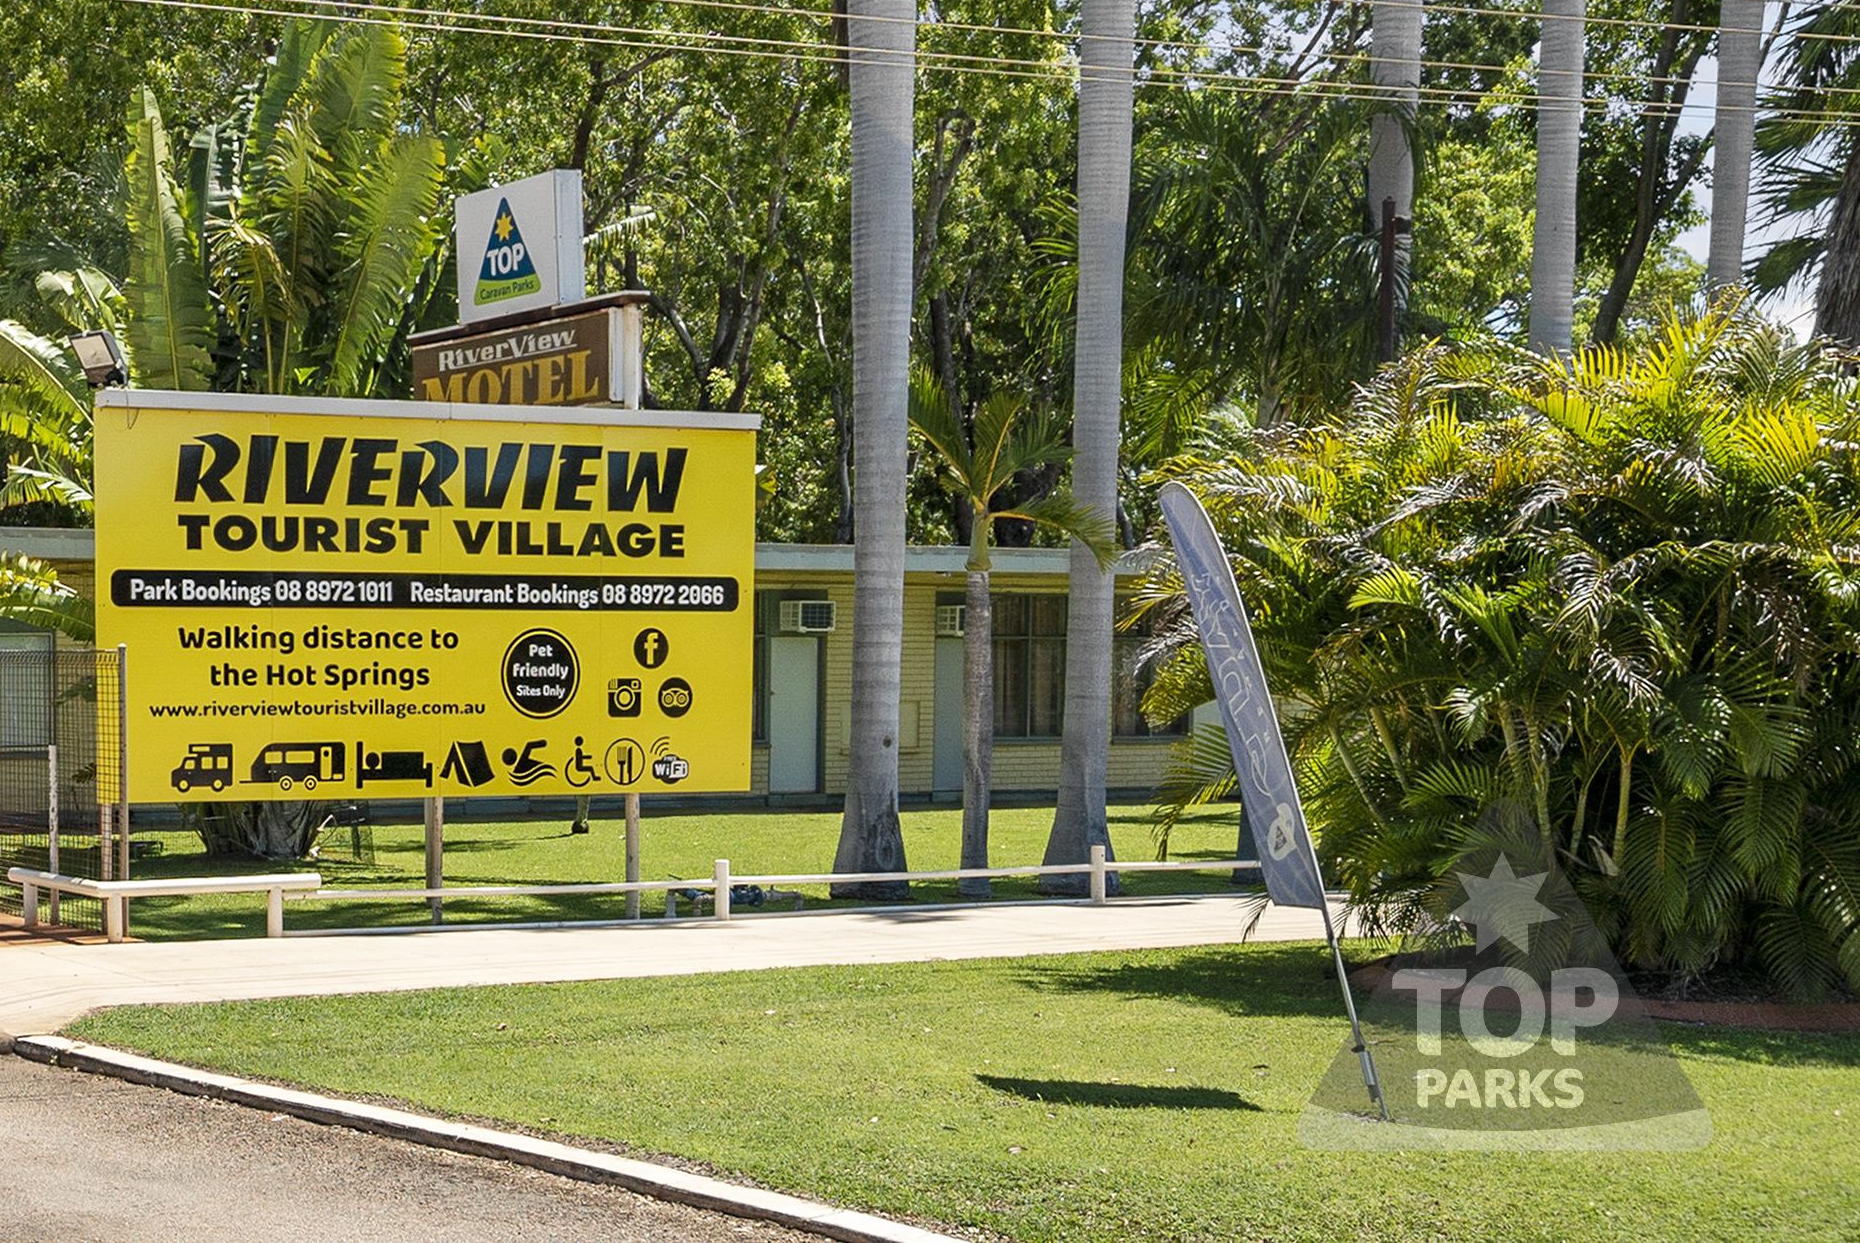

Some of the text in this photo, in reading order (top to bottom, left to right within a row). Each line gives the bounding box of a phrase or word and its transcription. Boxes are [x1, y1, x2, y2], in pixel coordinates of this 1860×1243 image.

[487, 242, 524, 276] TOP
[481, 279, 533, 300] Caravan Parks
[439, 329, 576, 371] RiverView
[422, 350, 598, 404] MOTEL
[174, 433, 688, 513] RIVERVIEW
[178, 514, 685, 558] TOURIST VILLAGE
[130, 579, 724, 609] Park Bookings 08 8972 1011 Restaurant Bookings 08 8972 2066
[178, 625, 459, 654] Walking distance to
[529, 644, 553, 657] Pet
[210, 662, 429, 691] the Hot Springs
[516, 684, 566, 699] Sites Only
[149, 698, 486, 719] www.riverviewtouristvillage.com.au
[654, 763, 686, 776] WiFi
